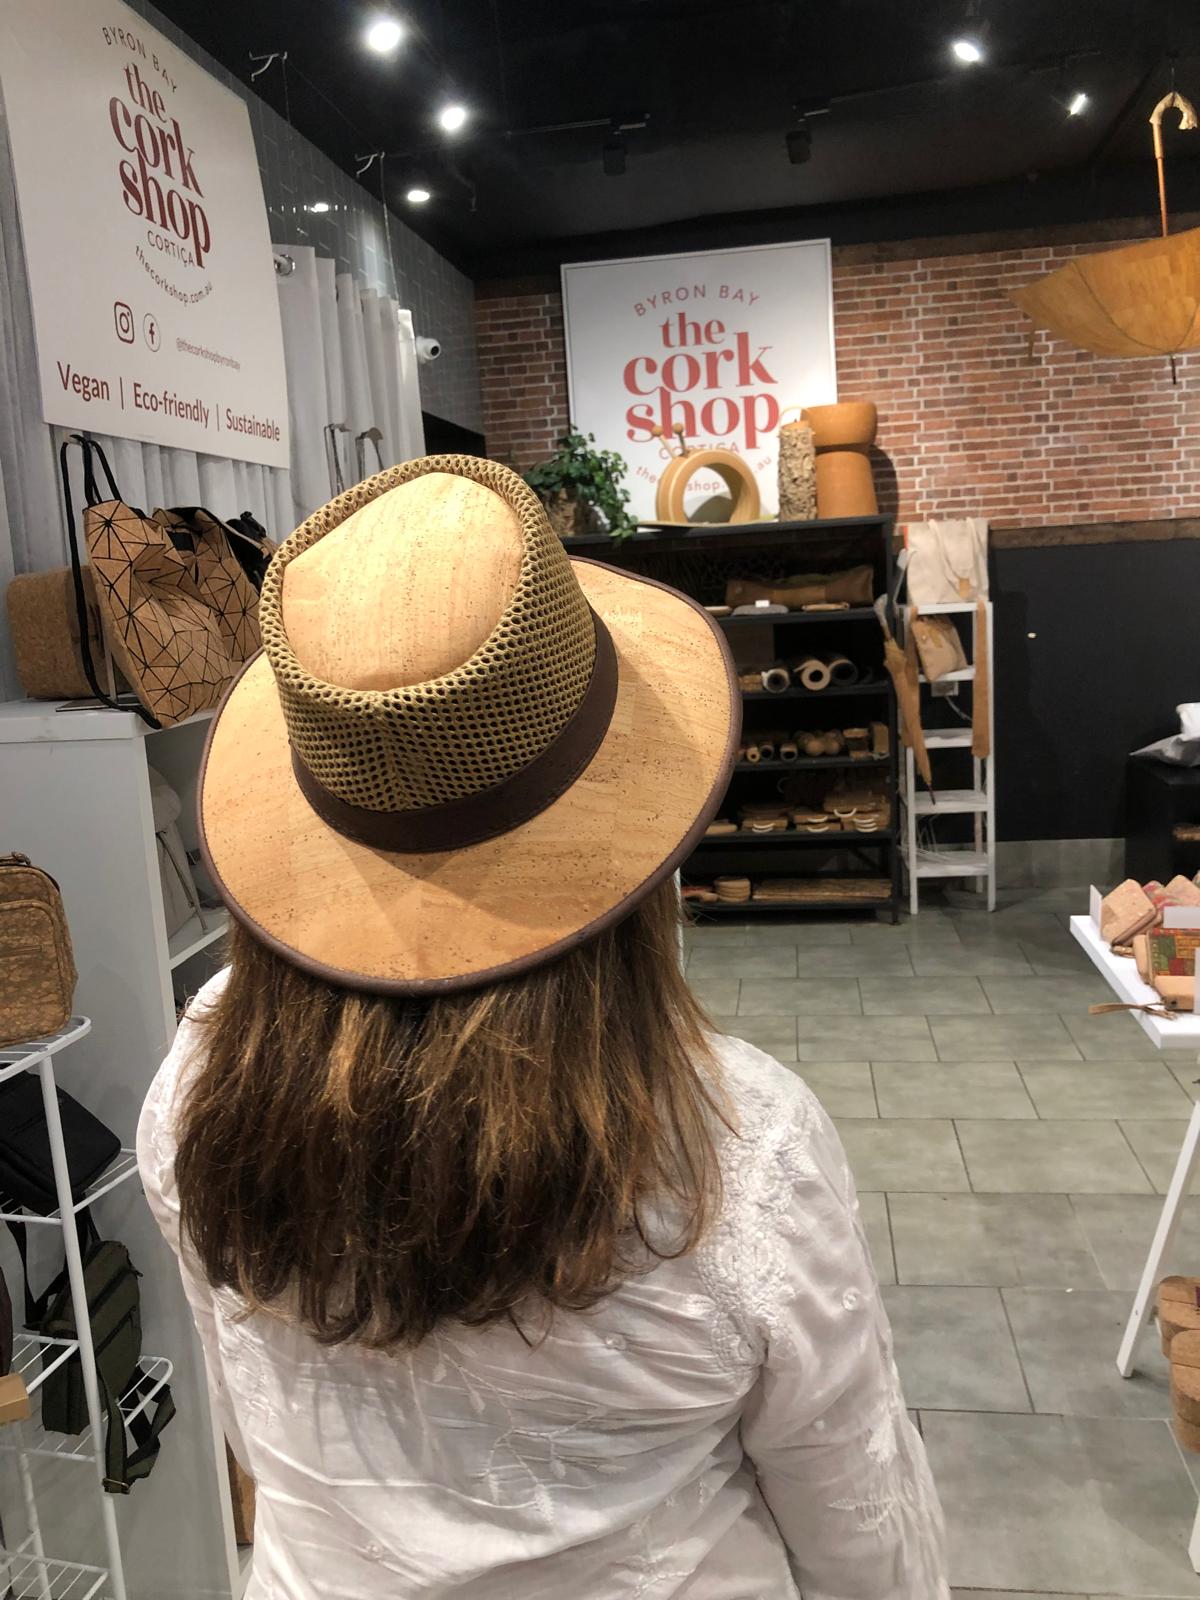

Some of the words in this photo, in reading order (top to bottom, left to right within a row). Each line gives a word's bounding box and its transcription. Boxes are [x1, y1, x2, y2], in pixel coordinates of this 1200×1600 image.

[102, 27, 146, 59] BYRON
[152, 54, 177, 93] BAY
[123, 62, 167, 123] the
[109, 97, 204, 198] cork
[119, 146, 211, 269] shop
[634, 285, 706, 317] BYRON
[719, 285, 760, 306] BAY
[659, 312, 726, 348] the
[623, 331, 778, 396] cork
[57, 361, 110, 402] Vegan
[133, 382, 210, 429] Eco-friendly
[226, 408, 281, 442] Sustainable
[626, 386, 780, 450] shop
